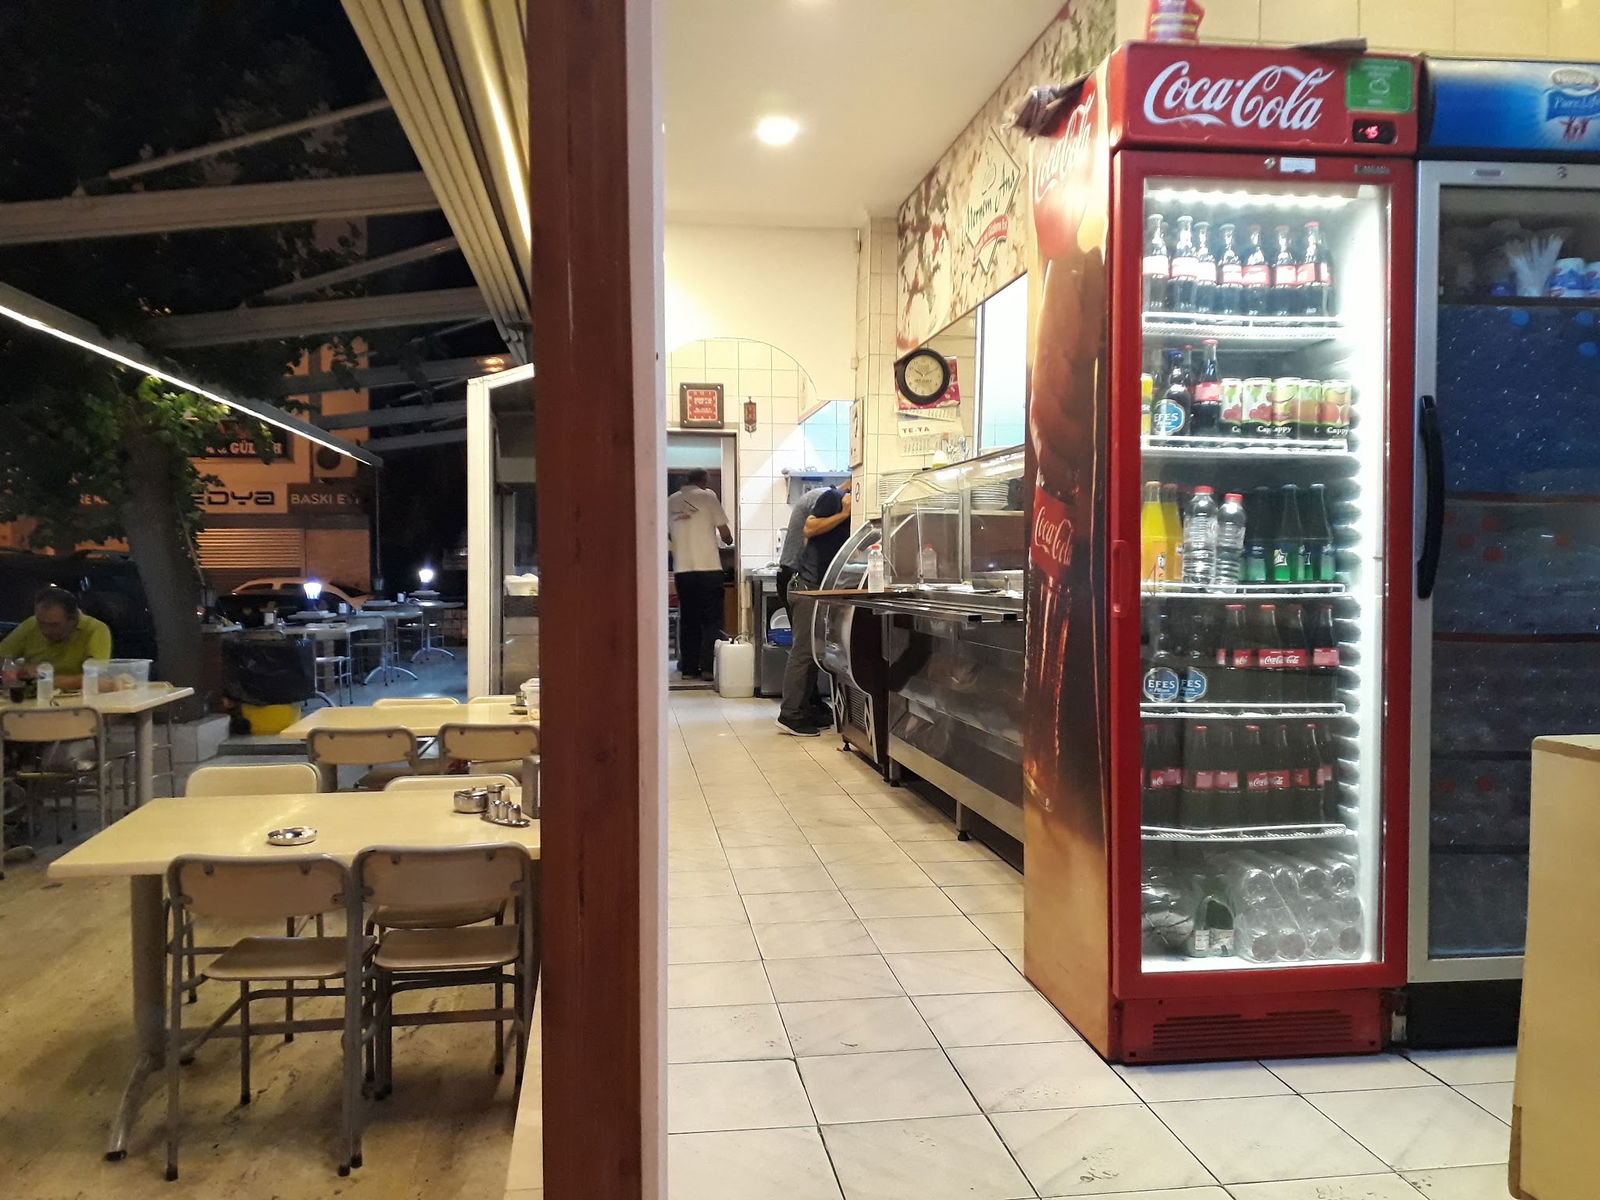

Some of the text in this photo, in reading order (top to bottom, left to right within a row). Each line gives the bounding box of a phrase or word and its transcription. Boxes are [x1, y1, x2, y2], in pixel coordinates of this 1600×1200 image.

[1143, 60, 1335, 130] Coca-Cola
[1153, 412, 1179, 422] EFES
[290, 493, 333, 505] BASKI
[1148, 679, 1176, 689] EFES
[1181, 679, 1202, 689] FES
